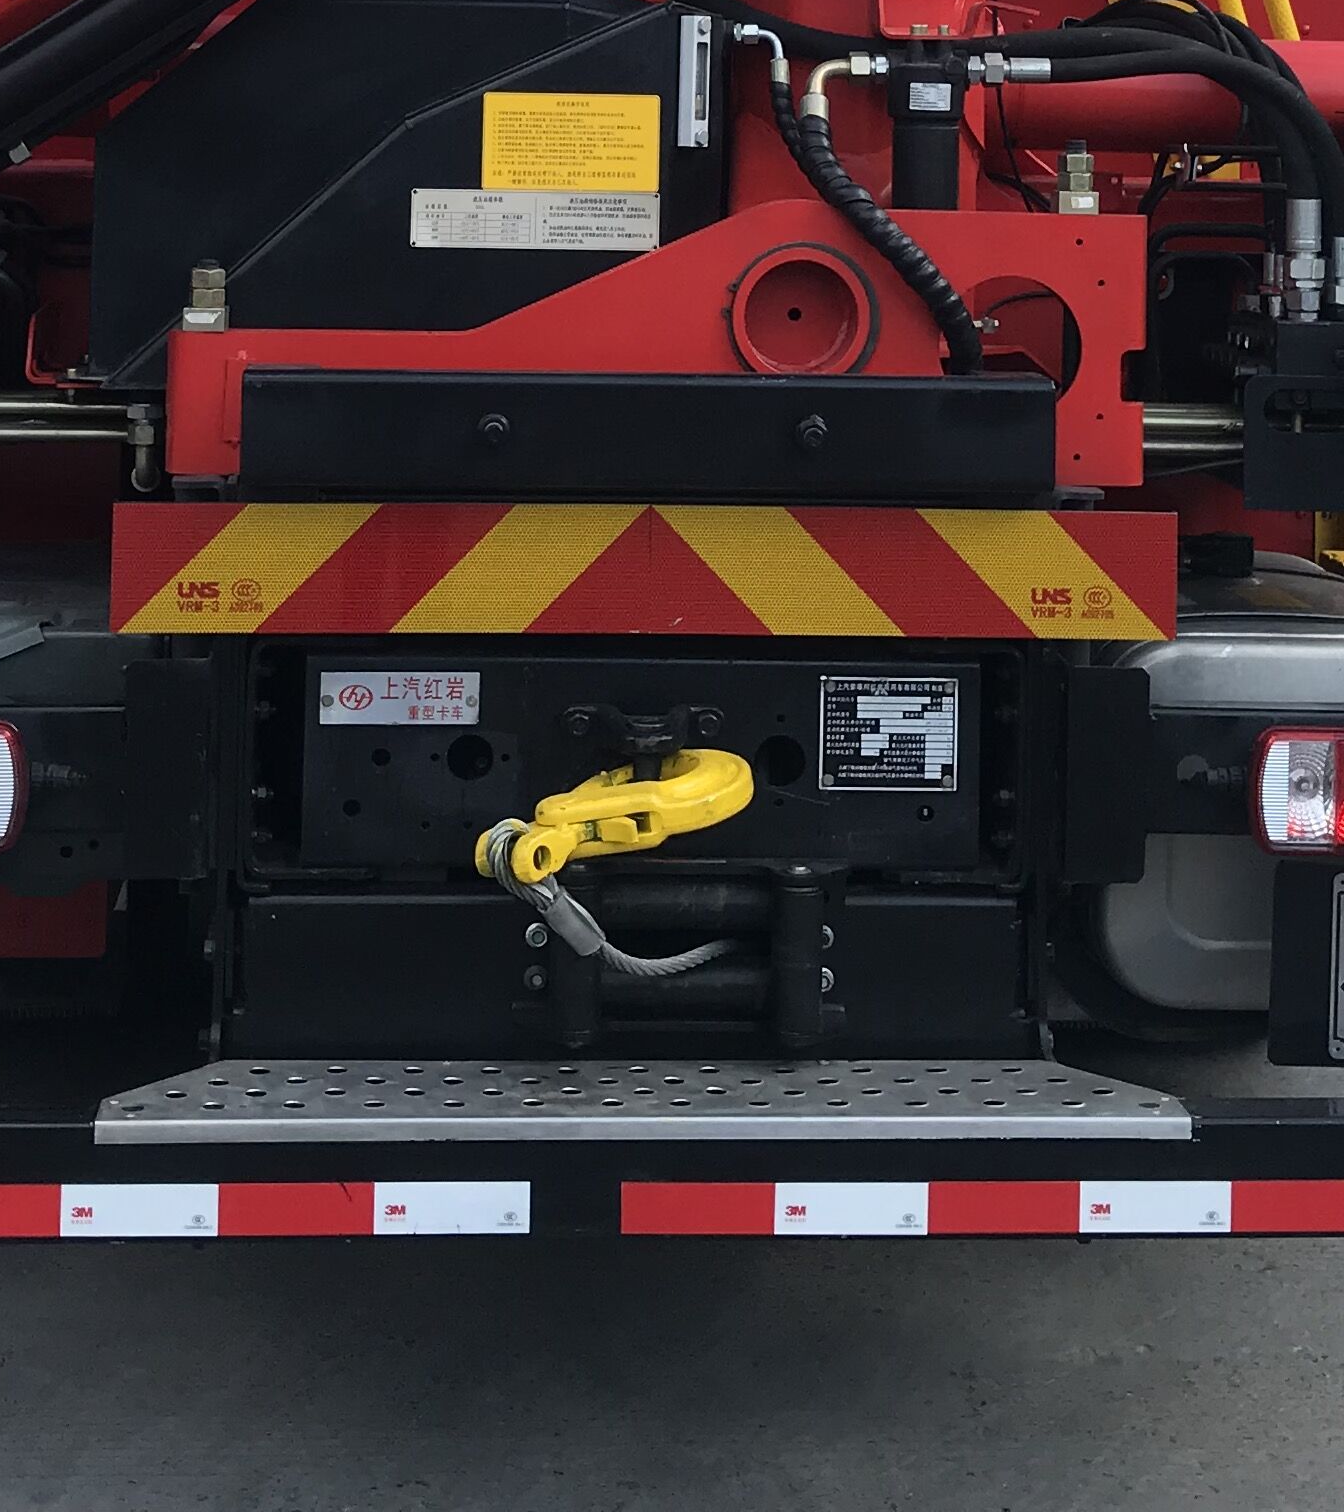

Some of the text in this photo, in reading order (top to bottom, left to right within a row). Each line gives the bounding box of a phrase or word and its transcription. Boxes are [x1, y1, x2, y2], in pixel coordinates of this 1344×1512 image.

[379, 676, 465, 701] 上汽红岩
[408, 705, 464, 721] 重型卡车
[71, 1207, 93, 1218] 3M
[384, 1204, 406, 1216] 3M
[785, 1205, 806, 1216] 3M
[1090, 1203, 1111, 1215] 3M
